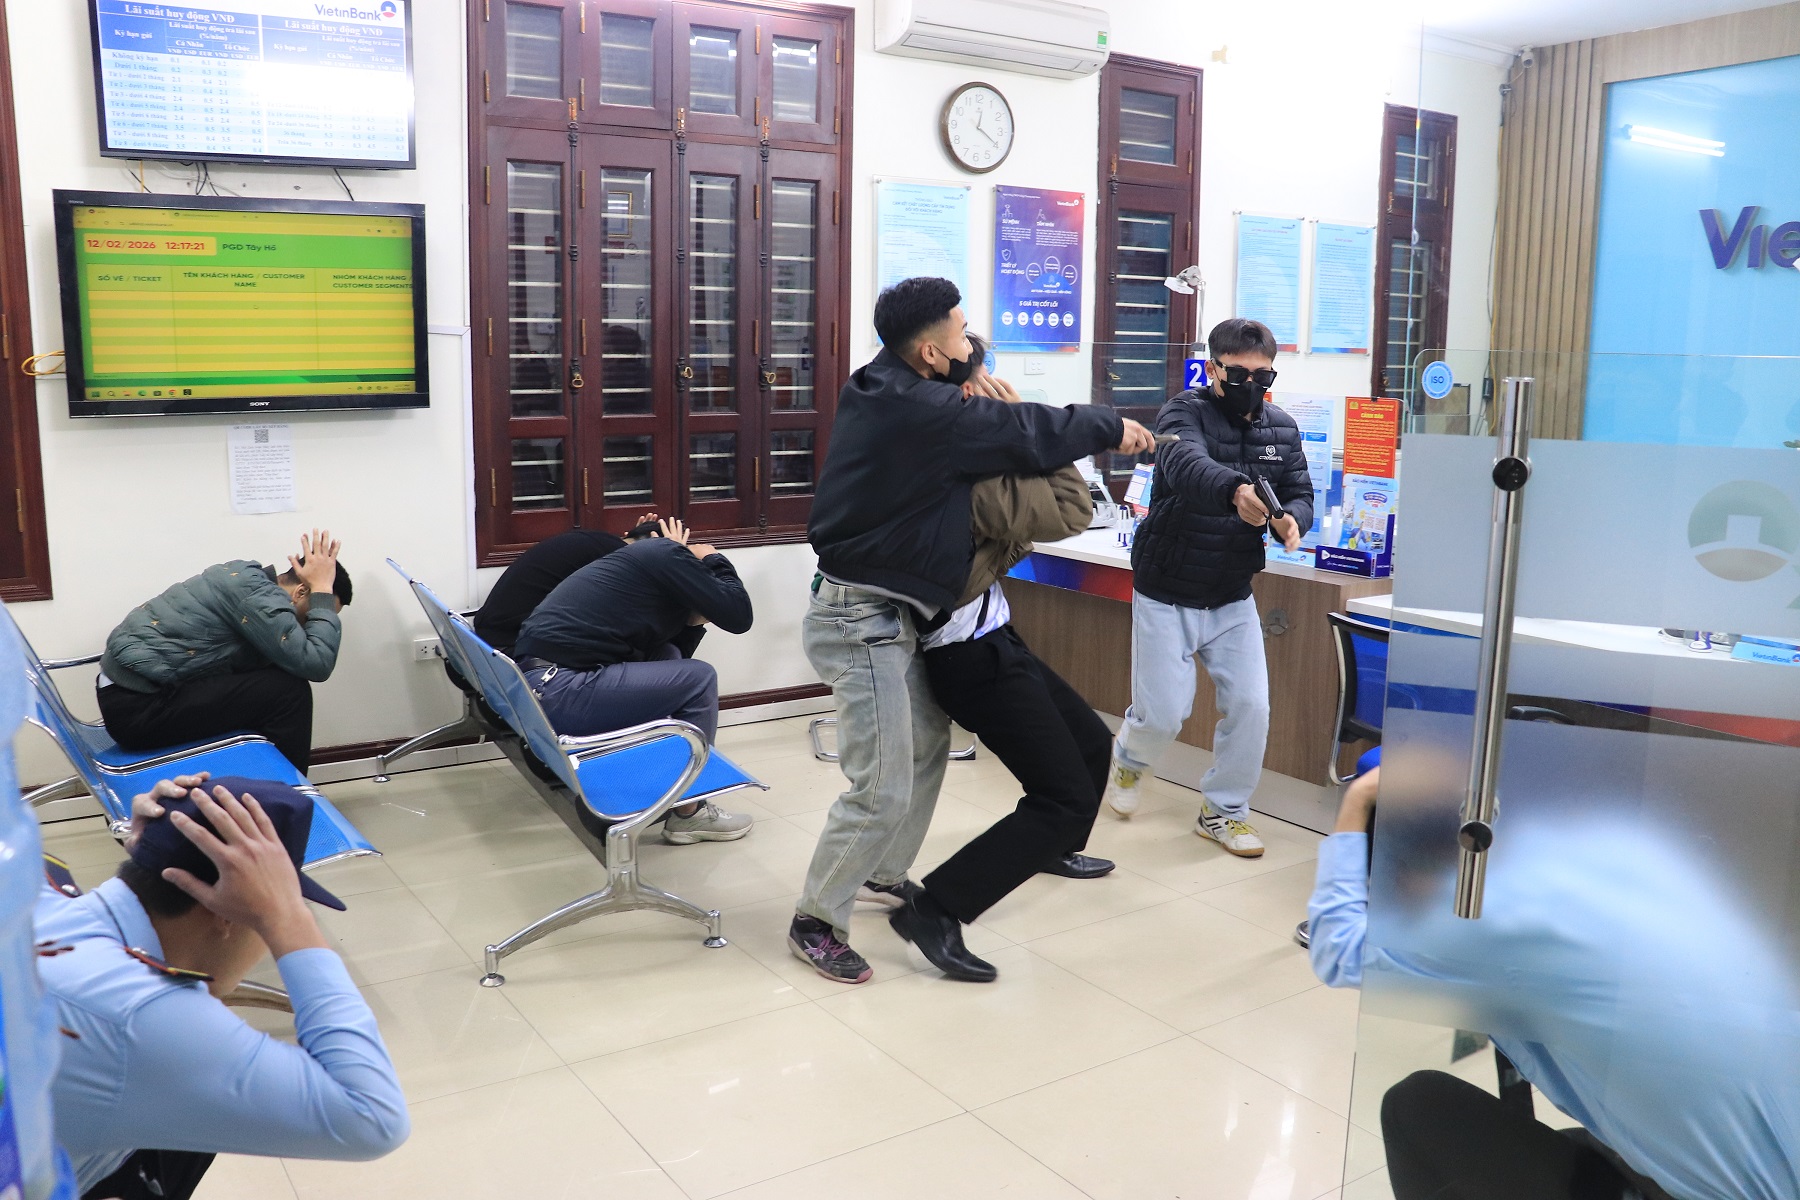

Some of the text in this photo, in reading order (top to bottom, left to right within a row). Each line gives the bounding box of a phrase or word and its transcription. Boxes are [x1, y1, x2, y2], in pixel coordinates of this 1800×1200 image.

[125, 4, 235, 23] Lãi suất huy động VNĐ
[314, 4, 381, 21] VietinBank
[285, 20, 382, 36] Lãi suất huy động VNĐ
[965, 97, 971, 106] 11
[975, 94, 983, 104] 12
[990, 100, 992, 108] 1
[956, 106, 964, 116] 10
[995, 112, 1001, 121] 2
[951, 120, 957, 129] 9
[997, 127, 1003, 136] 3
[954, 135, 960, 144] 8
[964, 148, 969, 156] 7
[984, 150, 990, 159] 5
[972, 153, 979, 162] 6
[1699, 206, 1800, 270] Vie
[87, 240, 205, 250] 12/02/2026 12:17:21
[1189, 362, 1202, 387] 2
[1430, 375, 1445, 384] ISO
[1753, 652, 1790, 663] VietinBank
